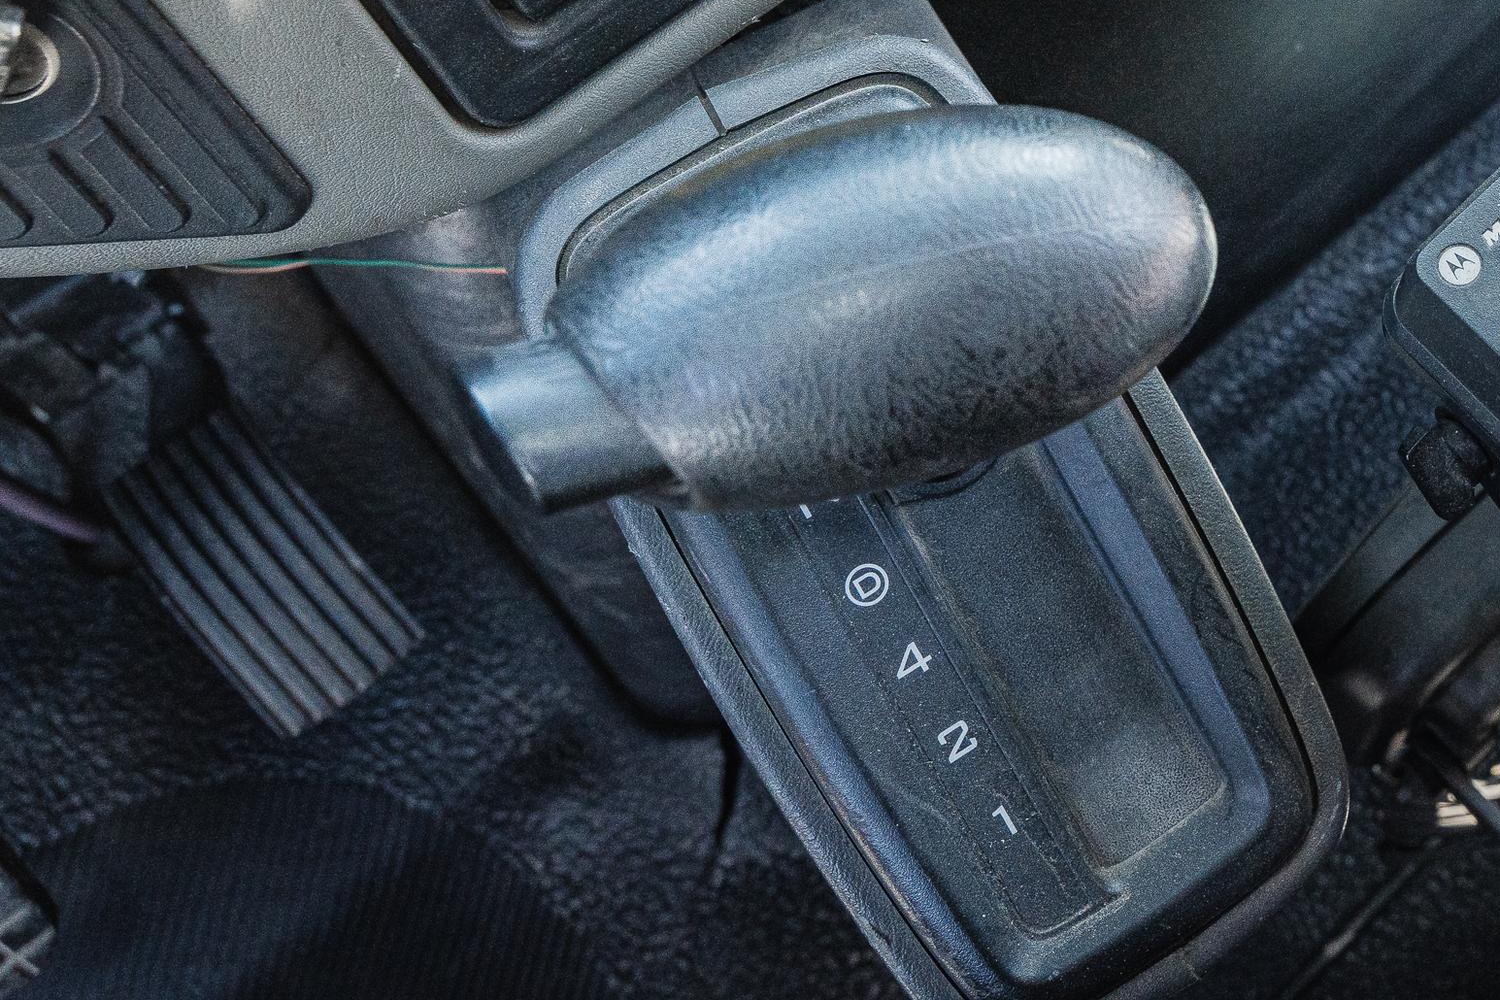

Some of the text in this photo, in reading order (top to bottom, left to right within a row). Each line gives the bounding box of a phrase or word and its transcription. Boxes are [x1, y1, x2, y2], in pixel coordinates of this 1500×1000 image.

[850, 568, 885, 602] D
[897, 642, 932, 680] 4
[937, 720, 977, 763] 2
[992, 805, 1018, 835] 1
